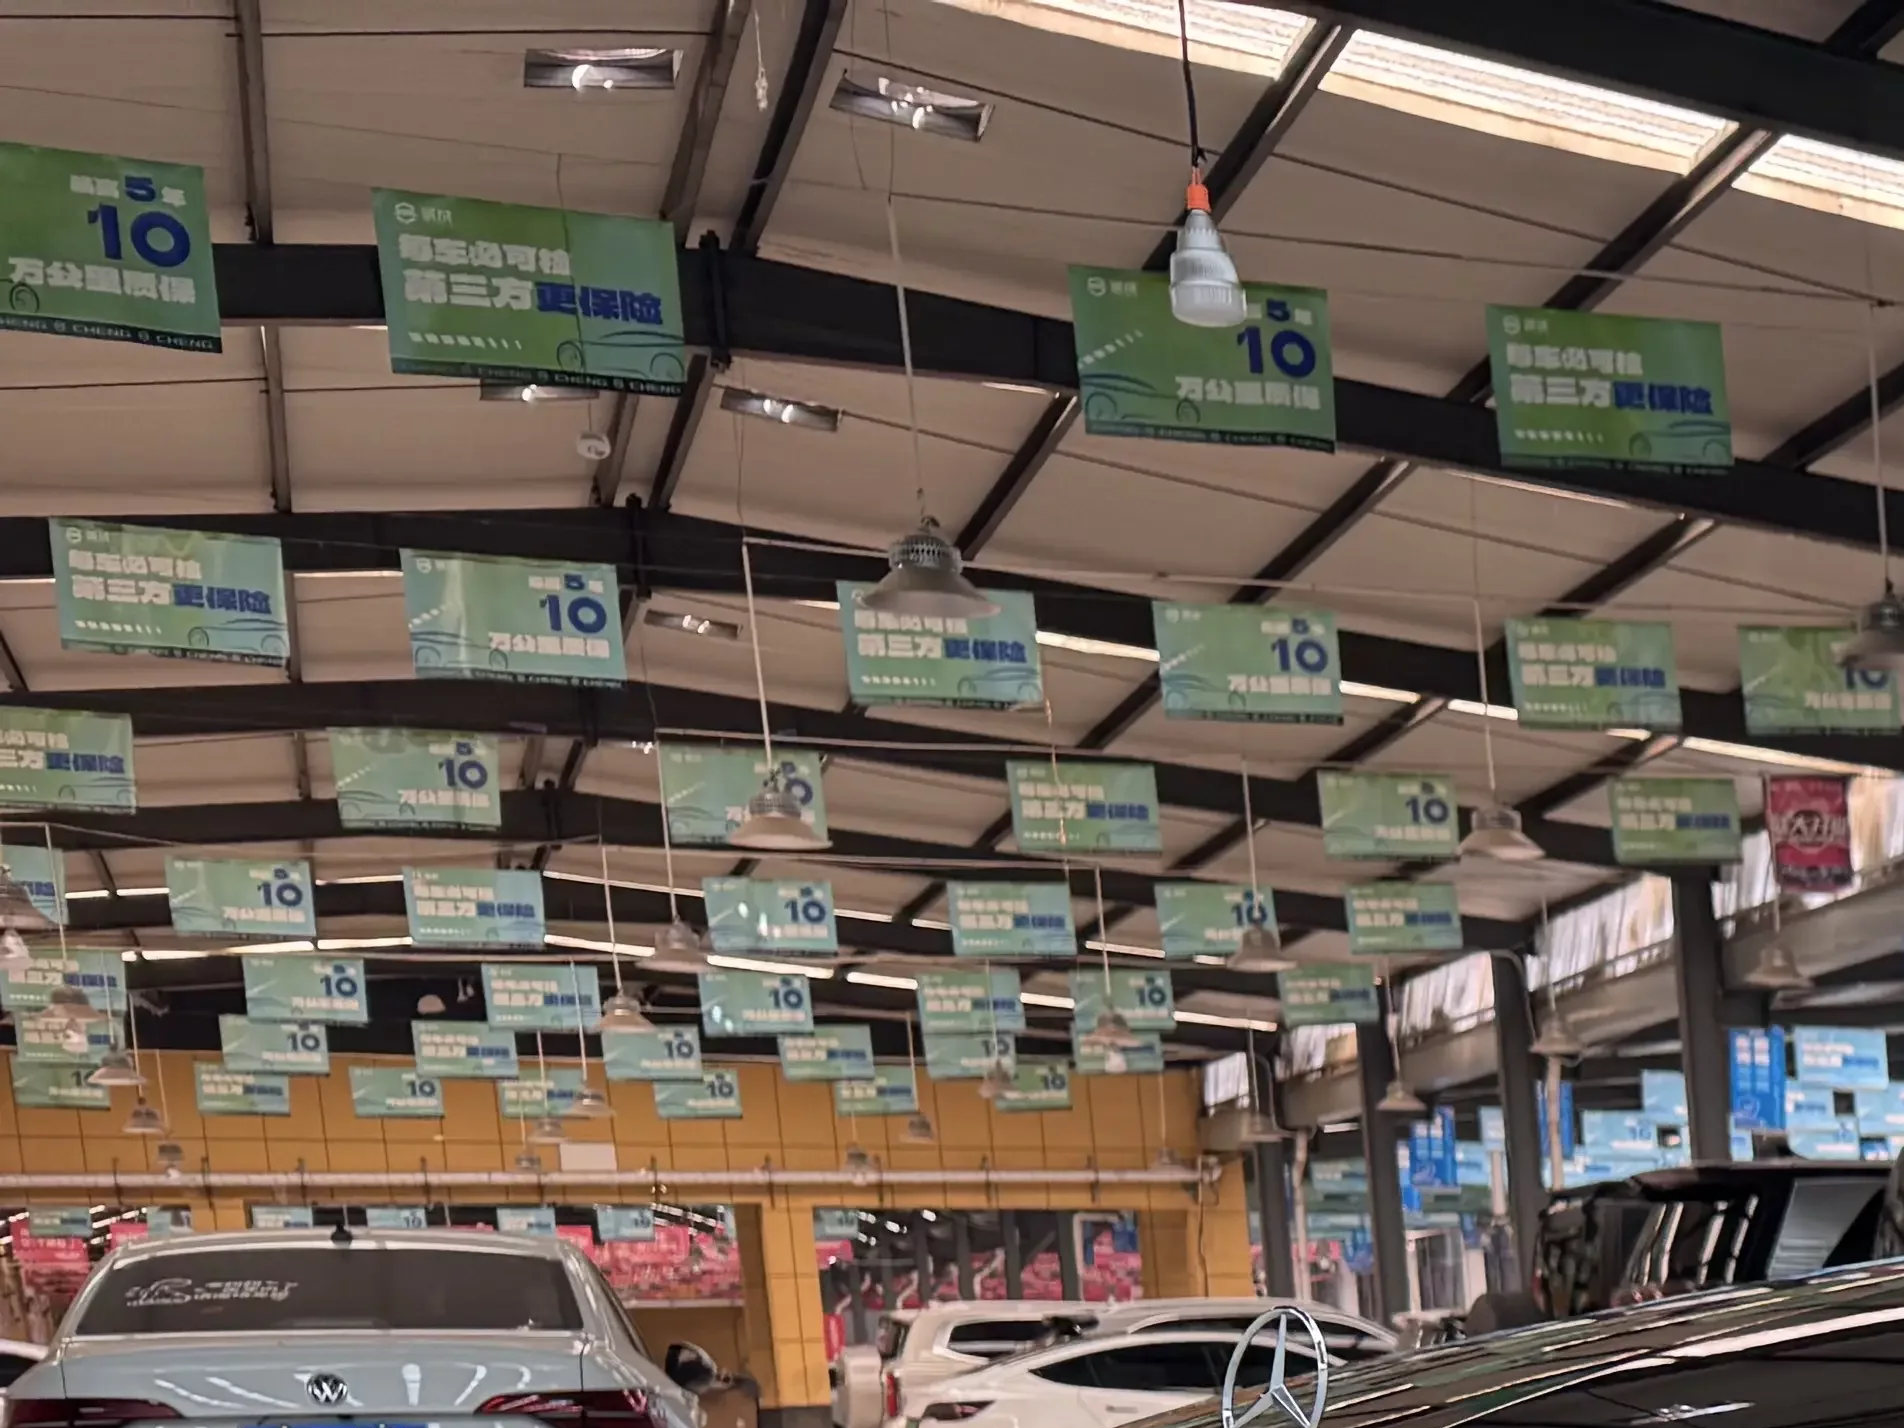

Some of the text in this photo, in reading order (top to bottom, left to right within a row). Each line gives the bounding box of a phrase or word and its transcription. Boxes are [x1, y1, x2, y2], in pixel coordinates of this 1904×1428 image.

[87, 203, 191, 268] 10
[1237, 326, 1316, 379] 10
[539, 594, 608, 634] 10
[1271, 638, 1329, 674] 10
[437, 758, 488, 790] 10
[1405, 796, 1450, 825] 10
[256, 879, 304, 908] 10
[784, 899, 827, 925] 10
[319, 974, 358, 997] 10
